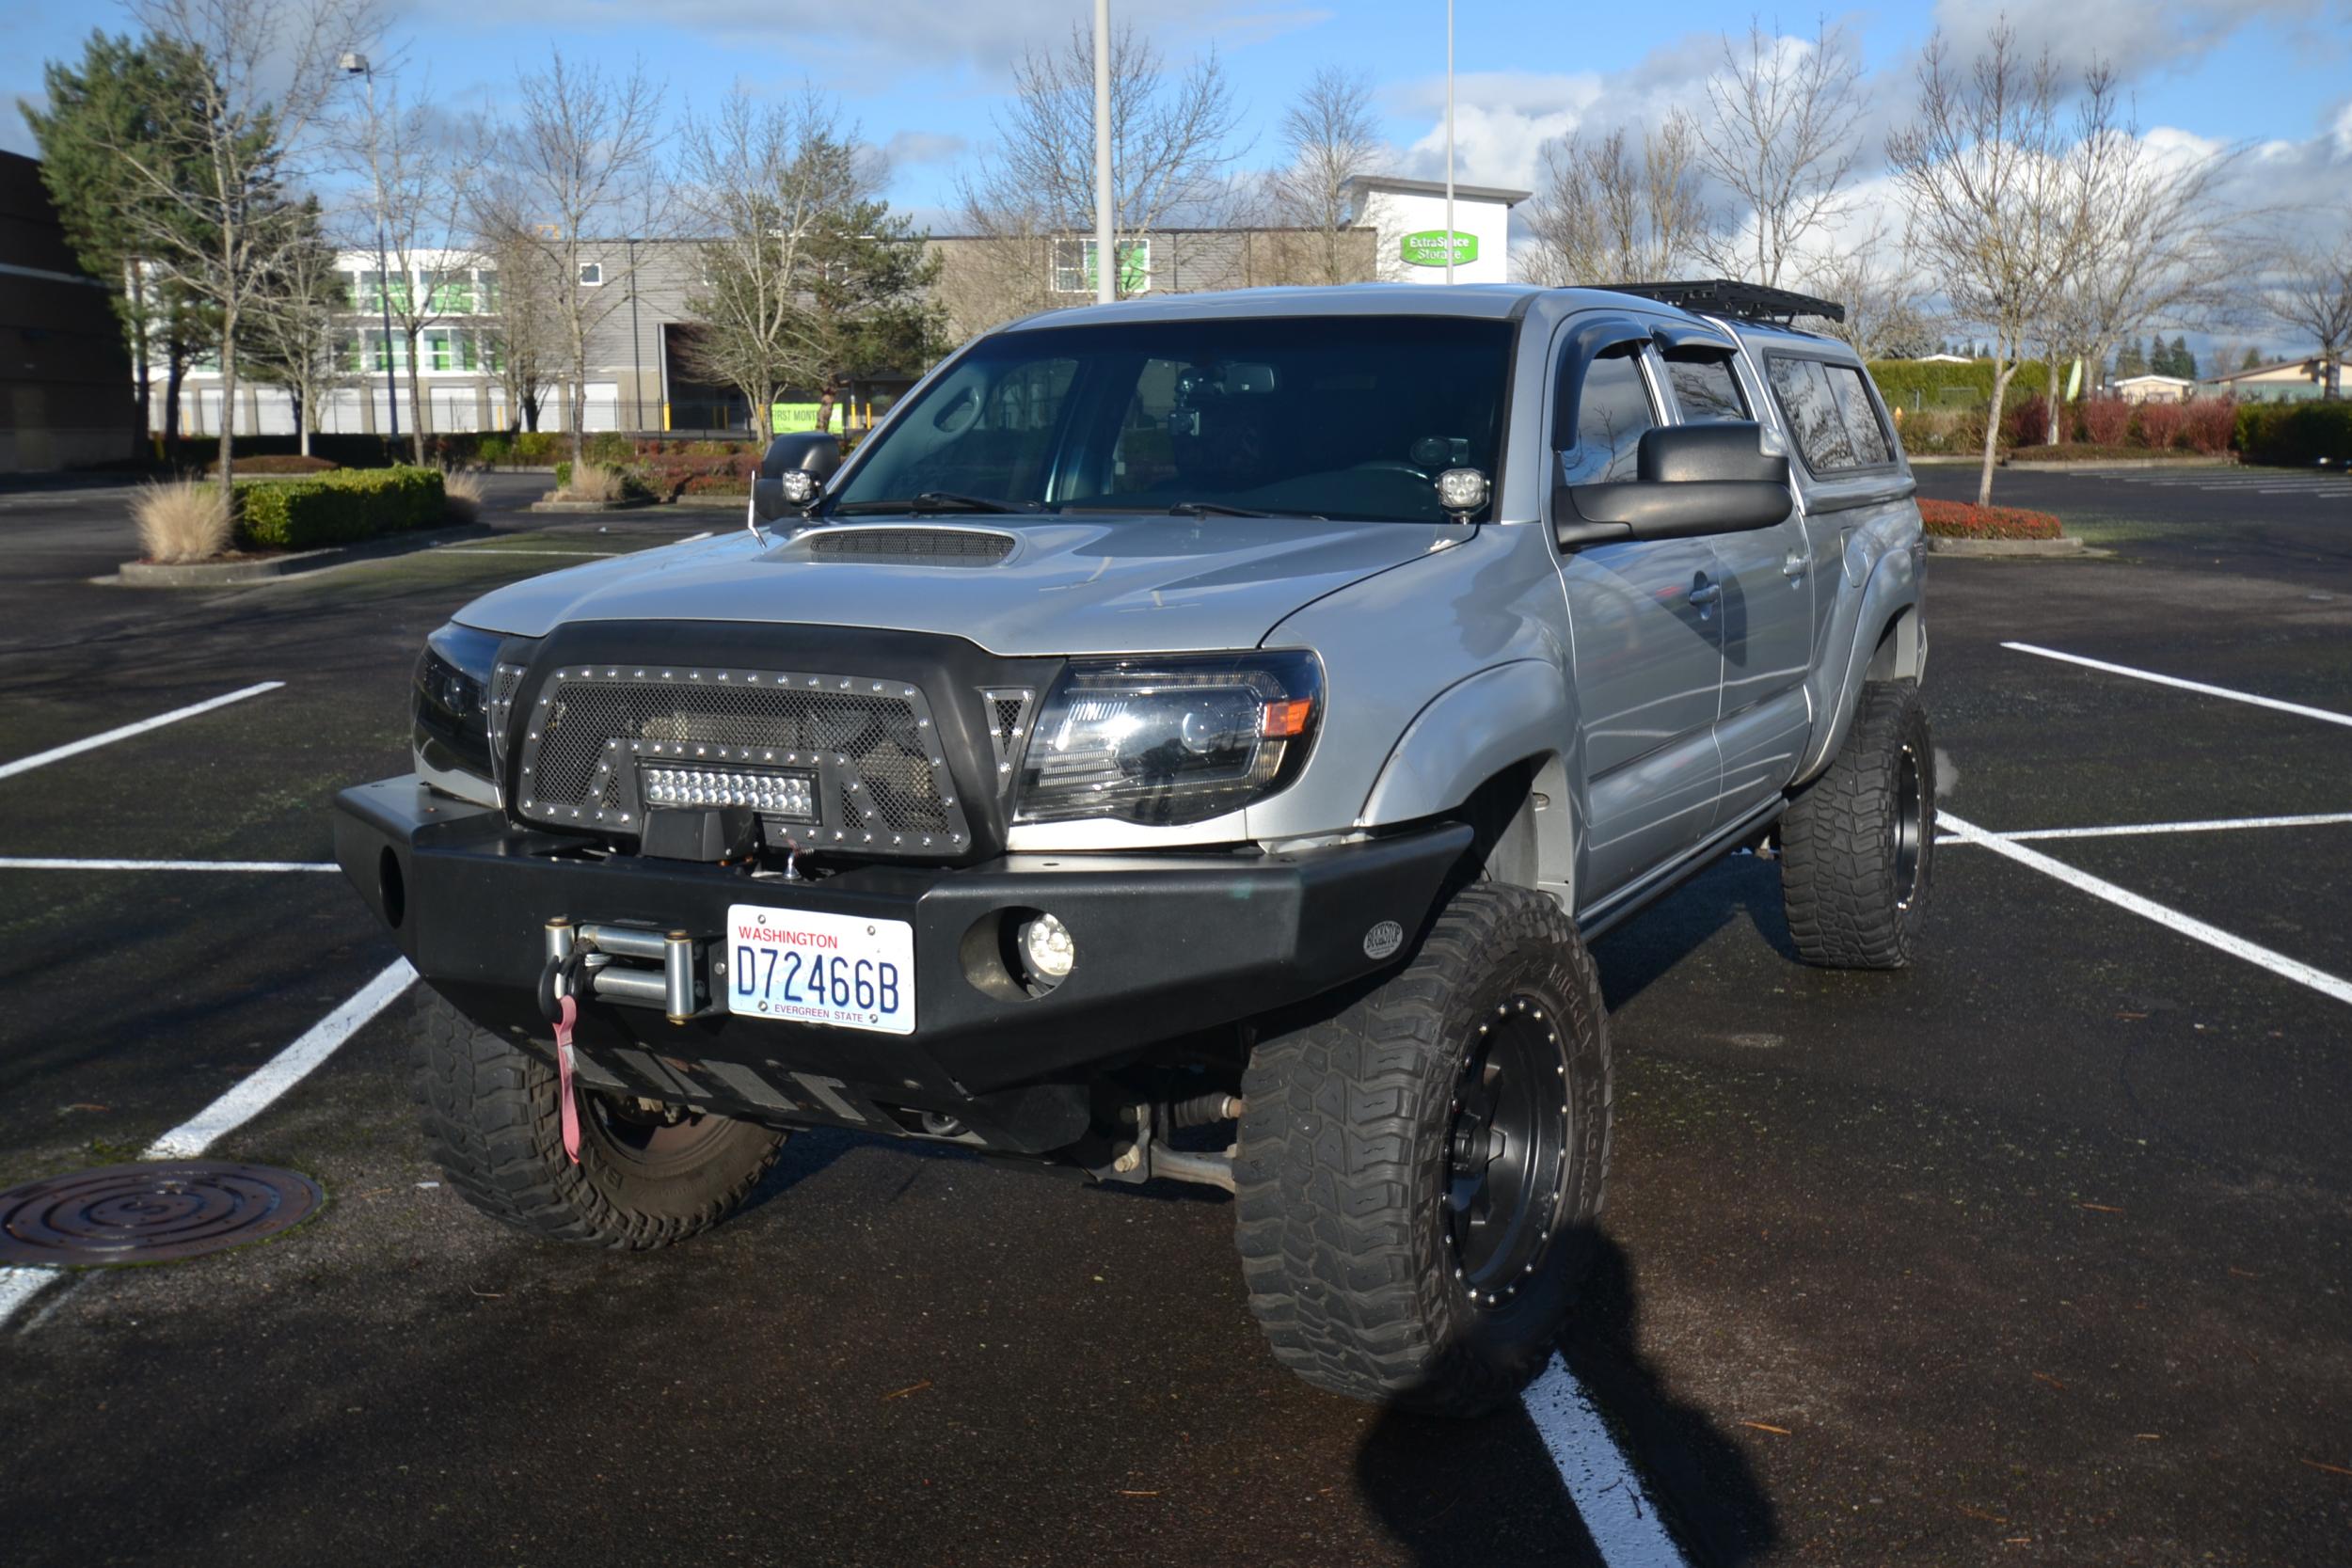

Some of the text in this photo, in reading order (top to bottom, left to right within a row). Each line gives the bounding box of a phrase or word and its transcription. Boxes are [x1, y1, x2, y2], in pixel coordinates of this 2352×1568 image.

[1418, 248, 1461, 260] Storae
[793, 410, 817, 422] MONT
[738, 926, 838, 949] WASHINGTON
[737, 945, 899, 1014] D72466B
[774, 1004, 864, 1022] EVERGREEN STATE
